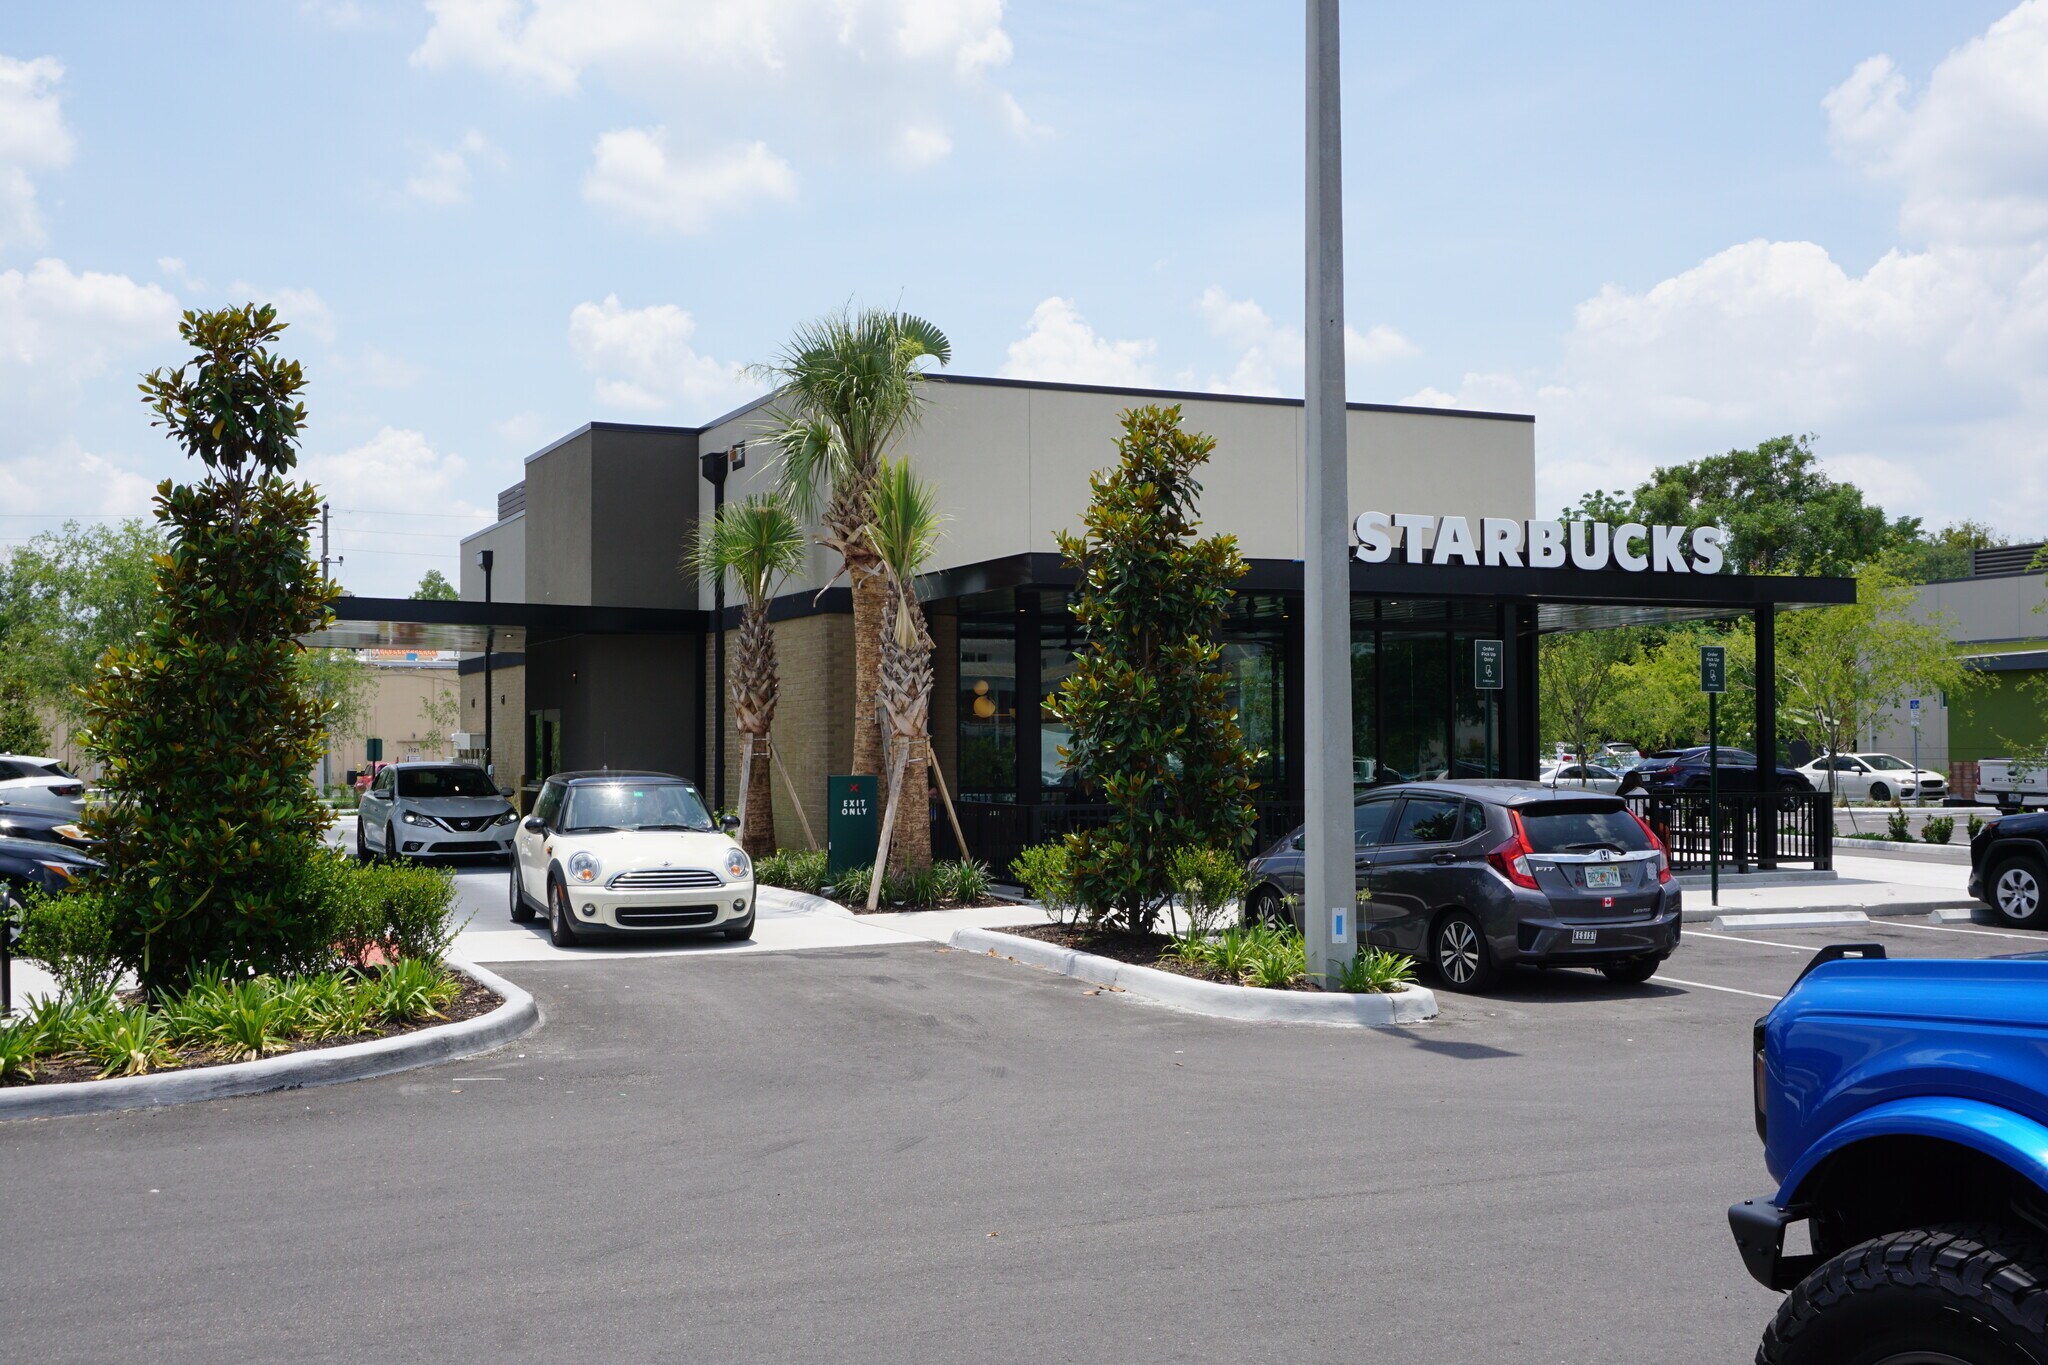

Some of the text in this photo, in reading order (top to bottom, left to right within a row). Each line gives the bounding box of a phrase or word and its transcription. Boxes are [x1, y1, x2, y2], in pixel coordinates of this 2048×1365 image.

[1353, 511, 1724, 574] STARBUCKS
[843, 799, 866, 807] EXIT
[841, 808, 868, 816] ONLY
